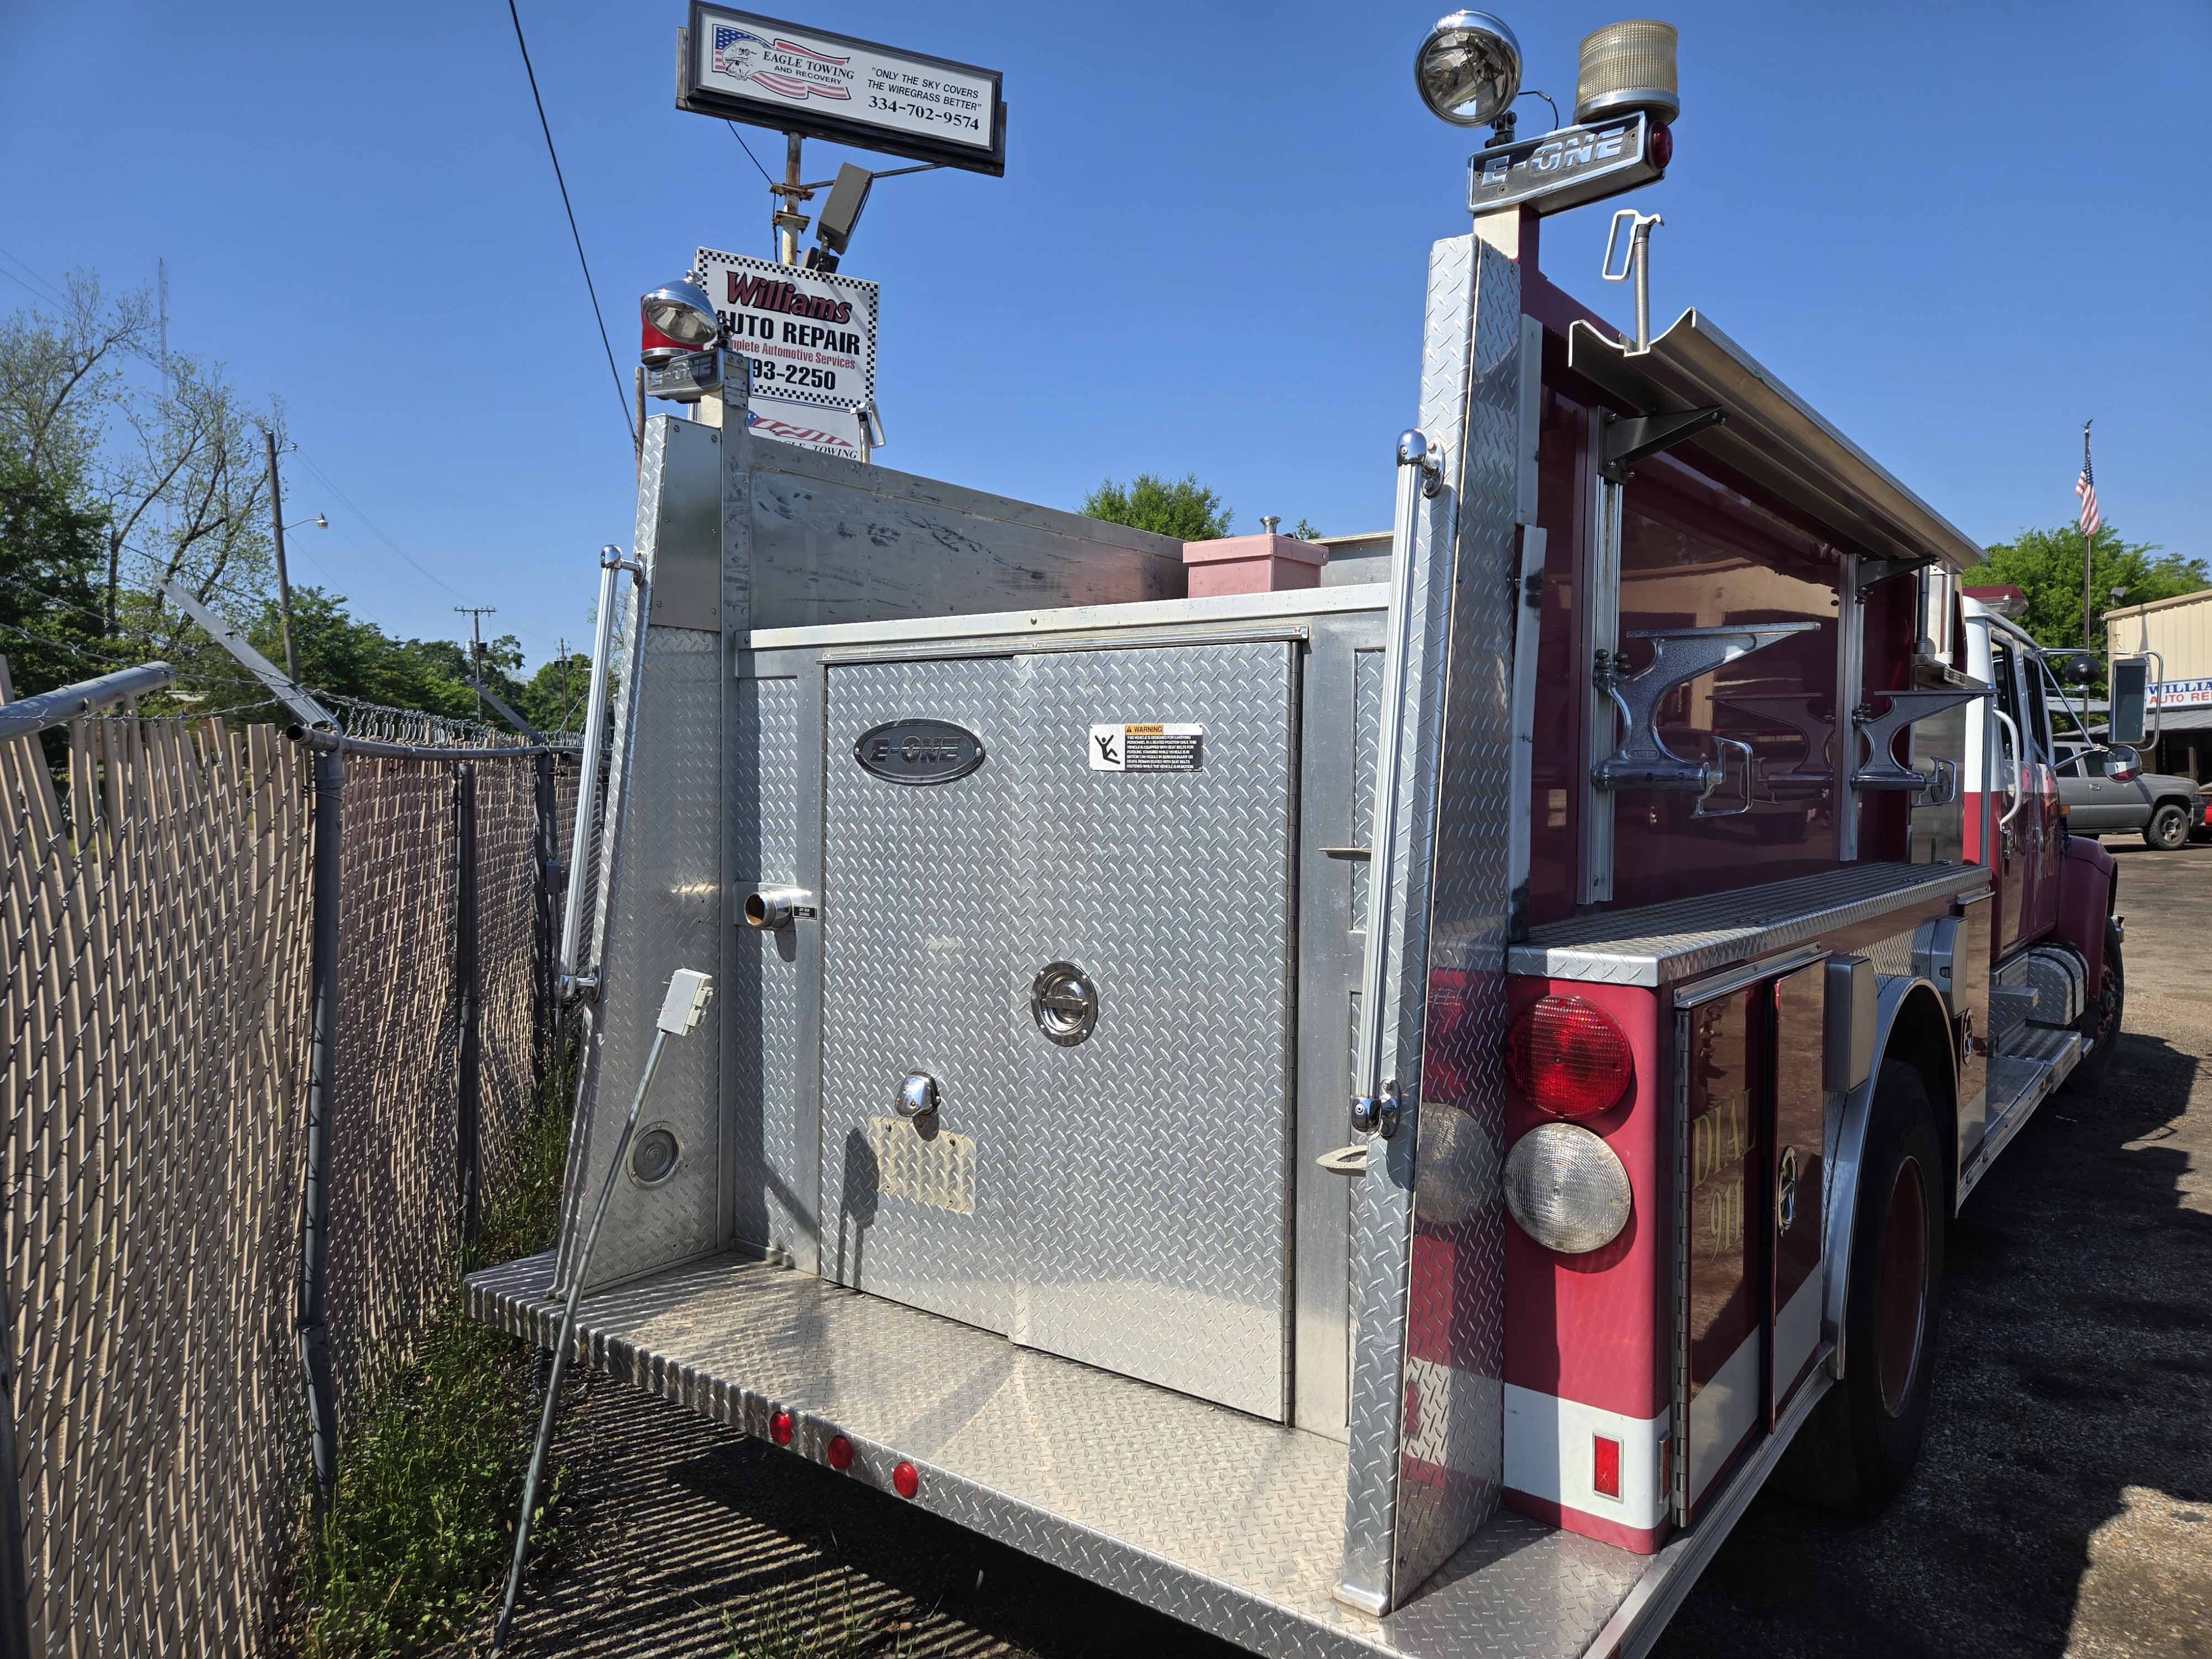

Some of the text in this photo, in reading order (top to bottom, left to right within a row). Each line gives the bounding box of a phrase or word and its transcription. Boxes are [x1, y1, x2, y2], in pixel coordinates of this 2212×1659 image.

[763, 51, 854, 80] EAGLE TOWING
[774, 65, 842, 84] AND RECOVERY
[868, 79, 982, 111] THE WIREGRASS BETTER"
[872, 67, 979, 98] "ONLY THE SKY COVERS
[868, 95, 979, 130] 334-702-9574
[1481, 126, 1626, 187] E-ONE
[726, 270, 853, 325] Williams
[732, 339, 855, 369] plete Automotive Services
[782, 321, 860, 356] REPAIR
[753, 358, 836, 390] 93-2250
[2190, 691, 2212, 702] RE
[870, 736, 961, 764] E-ONE
[1692, 1088, 1756, 1190] DIAL
[1708, 1176, 1744, 1265] 911
